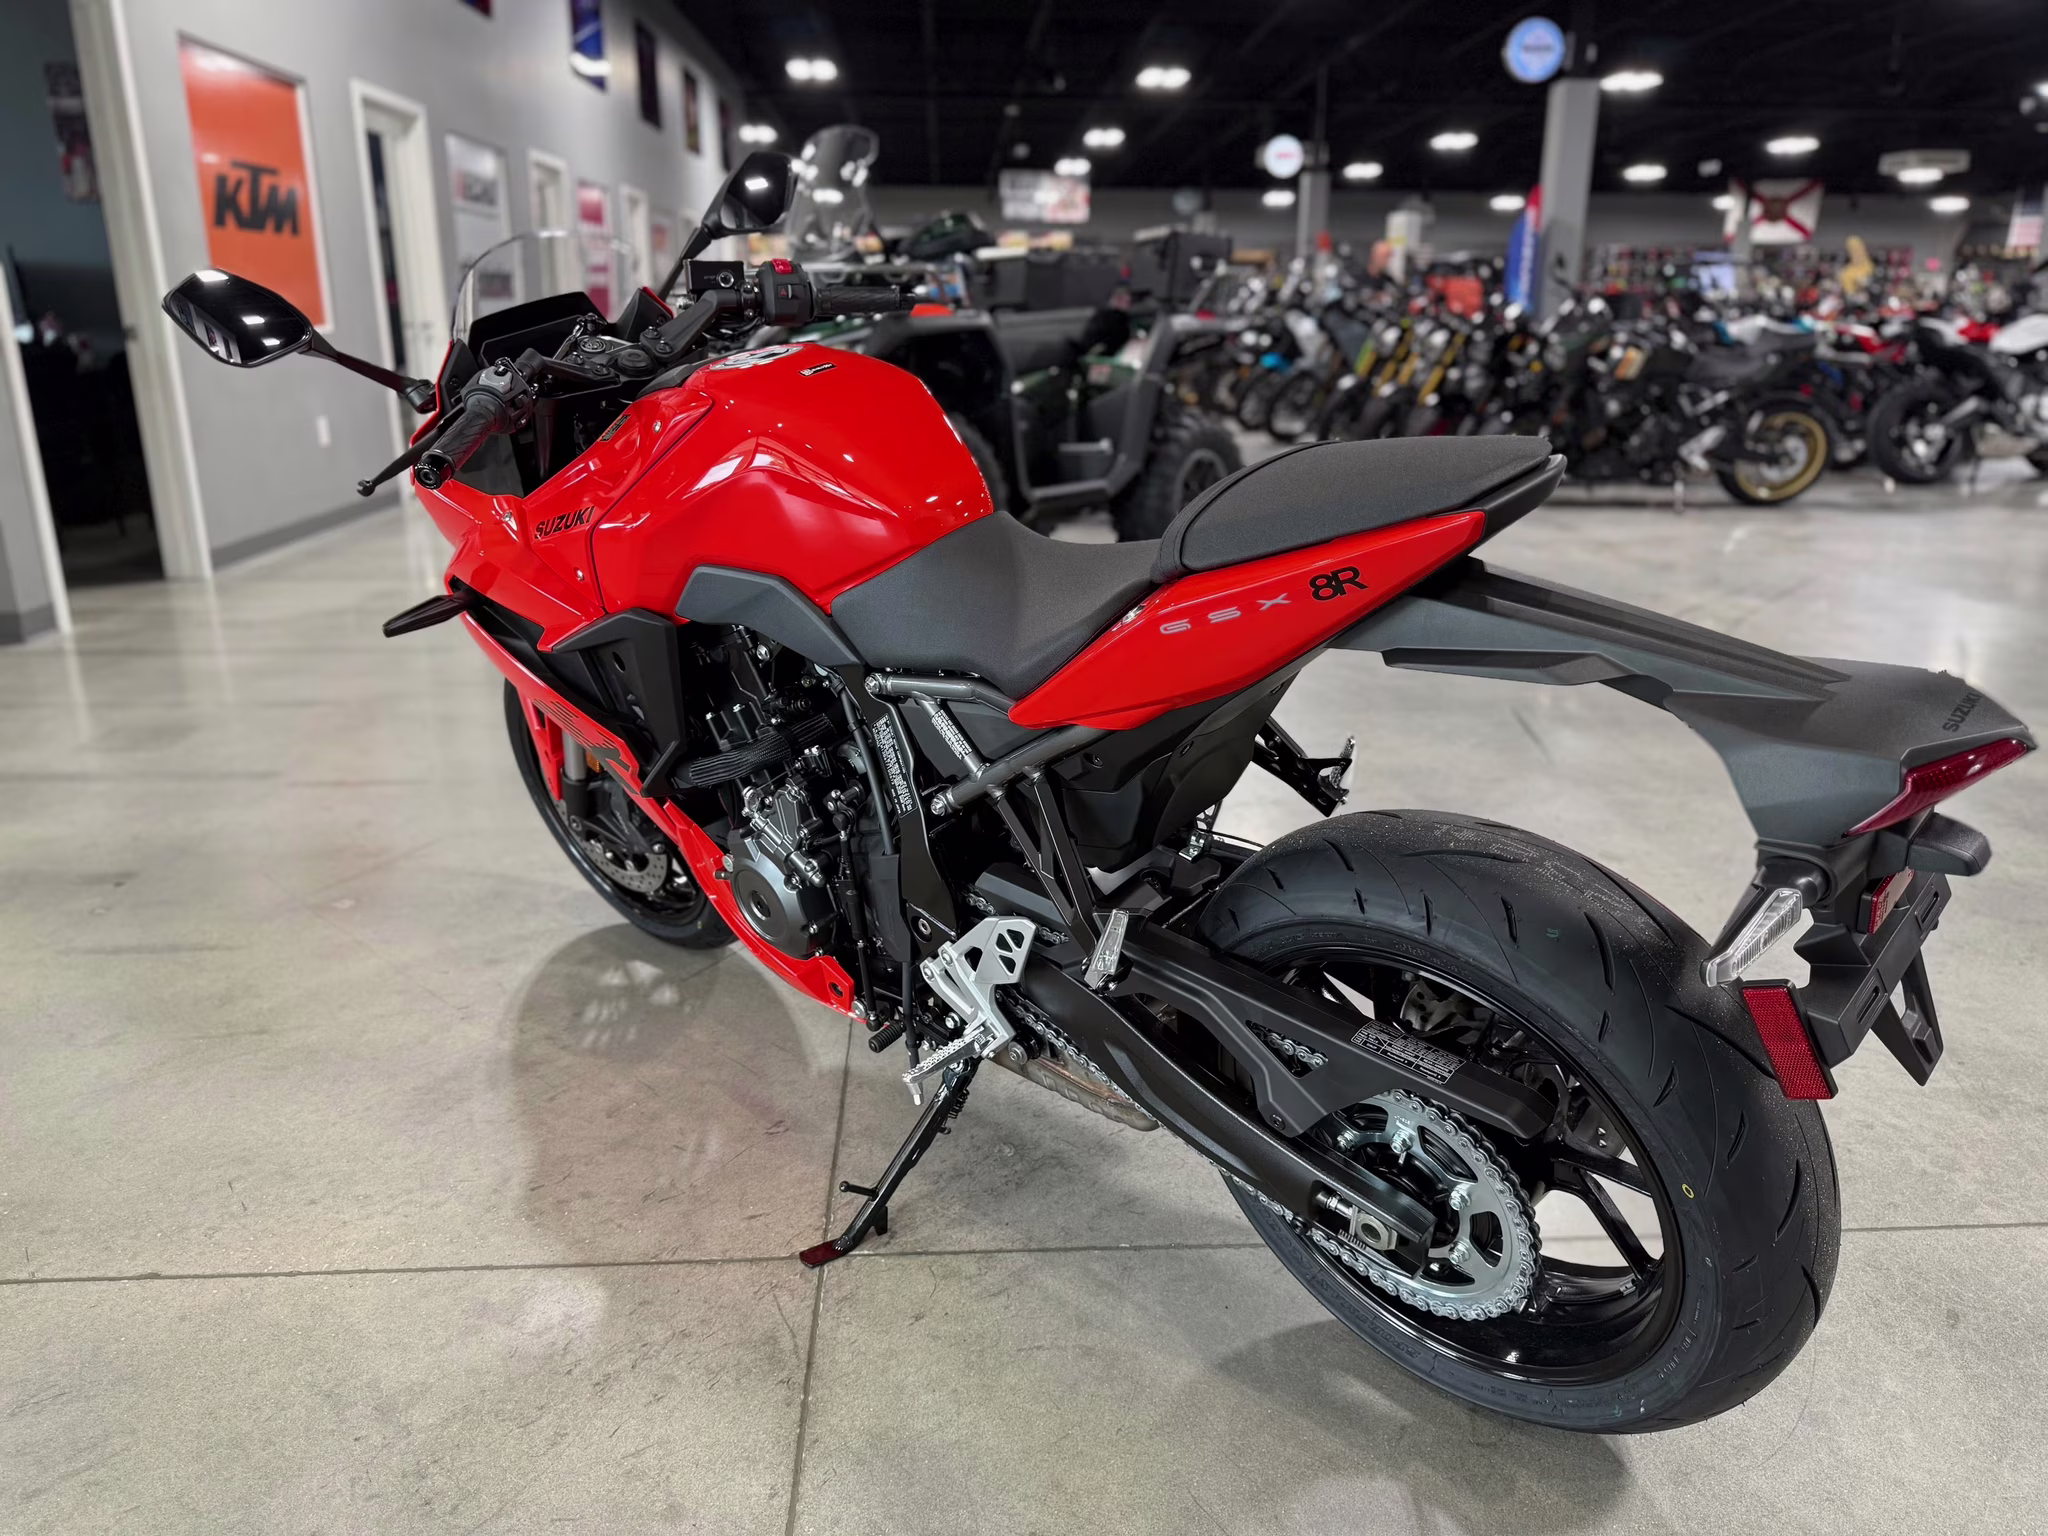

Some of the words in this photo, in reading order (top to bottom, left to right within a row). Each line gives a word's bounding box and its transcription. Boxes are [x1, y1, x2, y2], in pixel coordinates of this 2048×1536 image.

[214, 160, 300, 237] KTM
[534, 505, 595, 540] SUZUKI
[1309, 566, 1368, 601] 8R
[1942, 692, 1983, 732] SUZUKI
